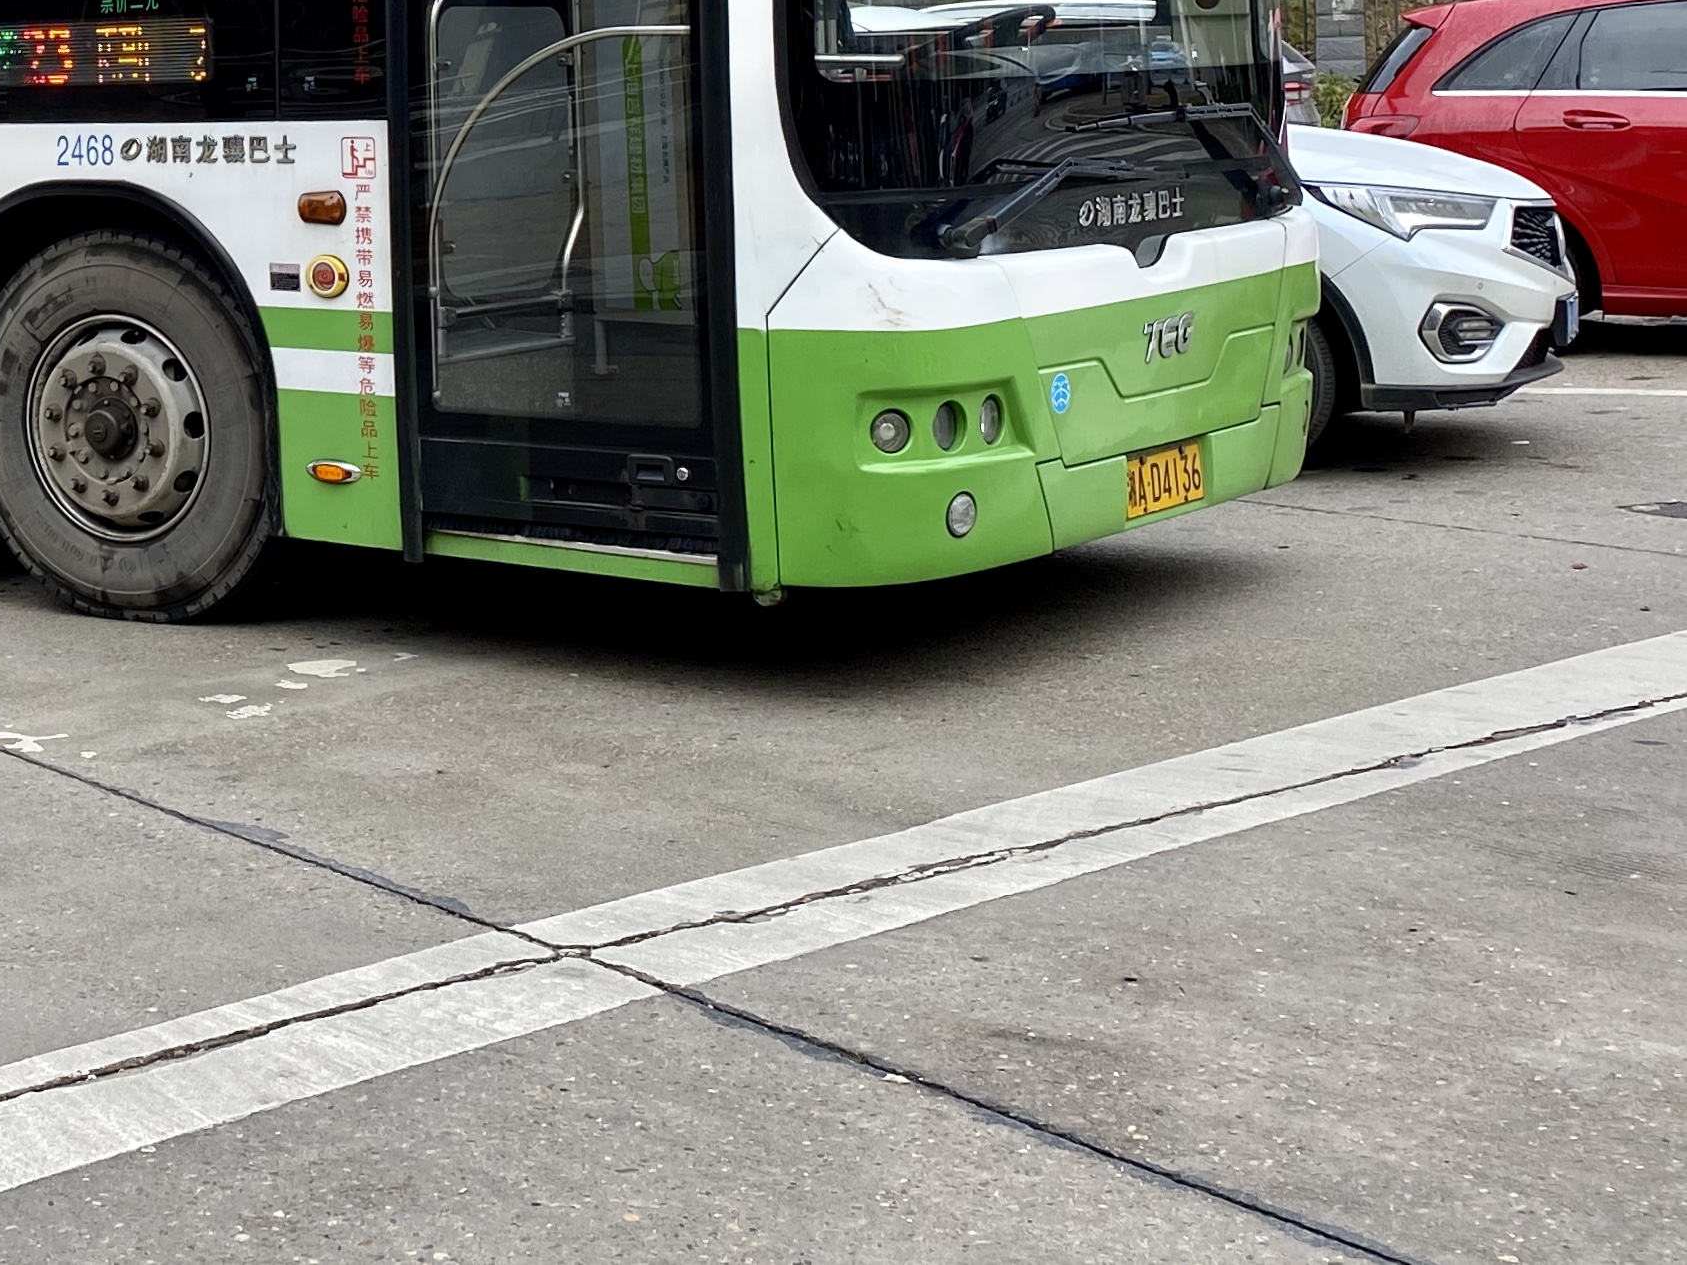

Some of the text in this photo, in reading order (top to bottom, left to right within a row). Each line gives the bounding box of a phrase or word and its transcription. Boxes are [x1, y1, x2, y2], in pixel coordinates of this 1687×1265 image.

[56, 134, 296, 166] 2468 湖南龙骧巴士
[1095, 187, 1185, 227] 湖南龙骧巴士
[355, 184, 380, 481] 严禁携带易燃易爆等危险品上车
